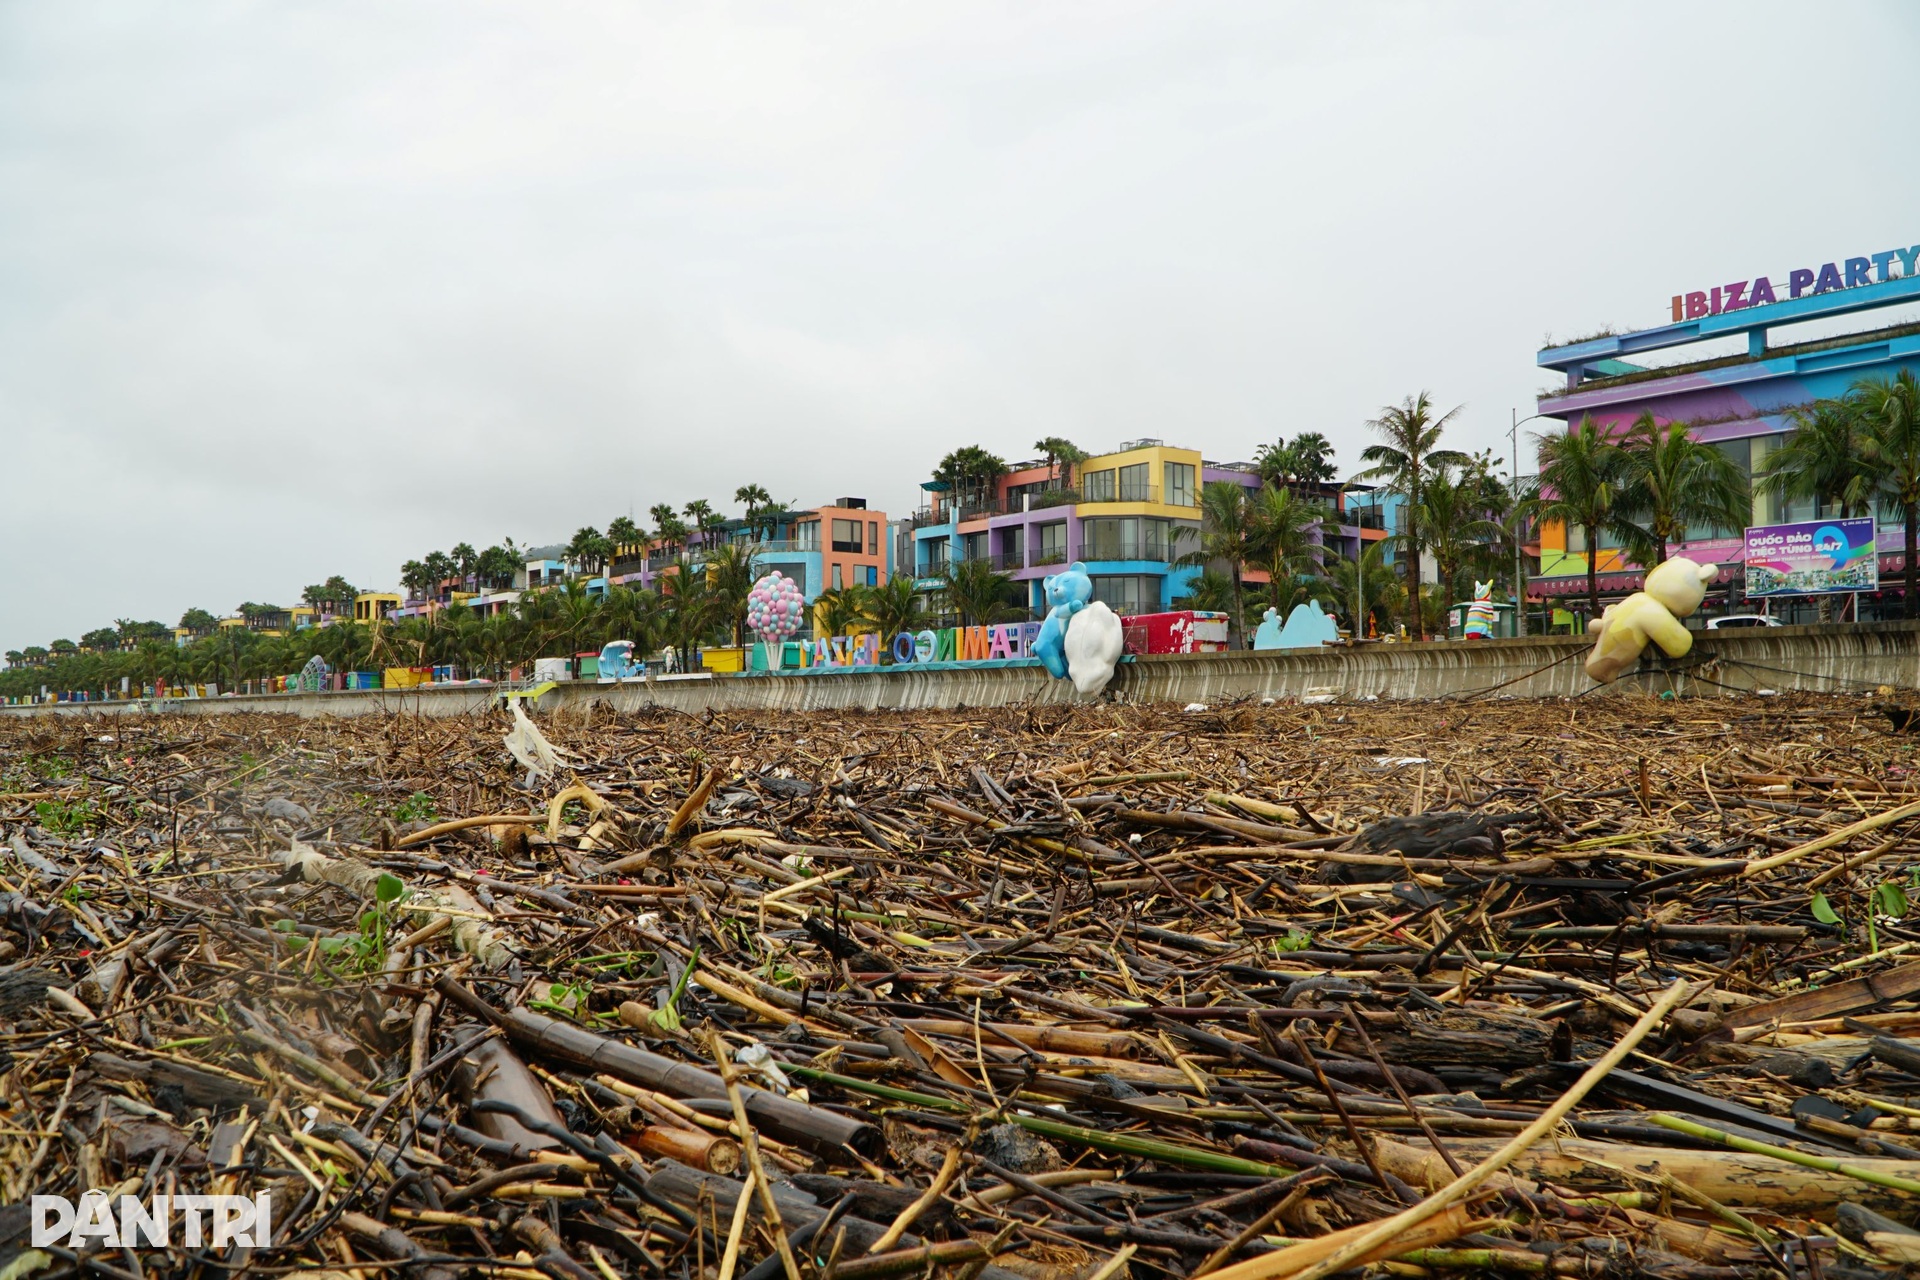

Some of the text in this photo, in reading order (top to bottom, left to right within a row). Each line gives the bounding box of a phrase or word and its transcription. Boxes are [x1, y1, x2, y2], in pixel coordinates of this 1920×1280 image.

[1671, 244, 1920, 323] IBIZA PARTY
[1748, 533, 1784, 547] QUỐC
[1815, 541, 1843, 552] 24/7
